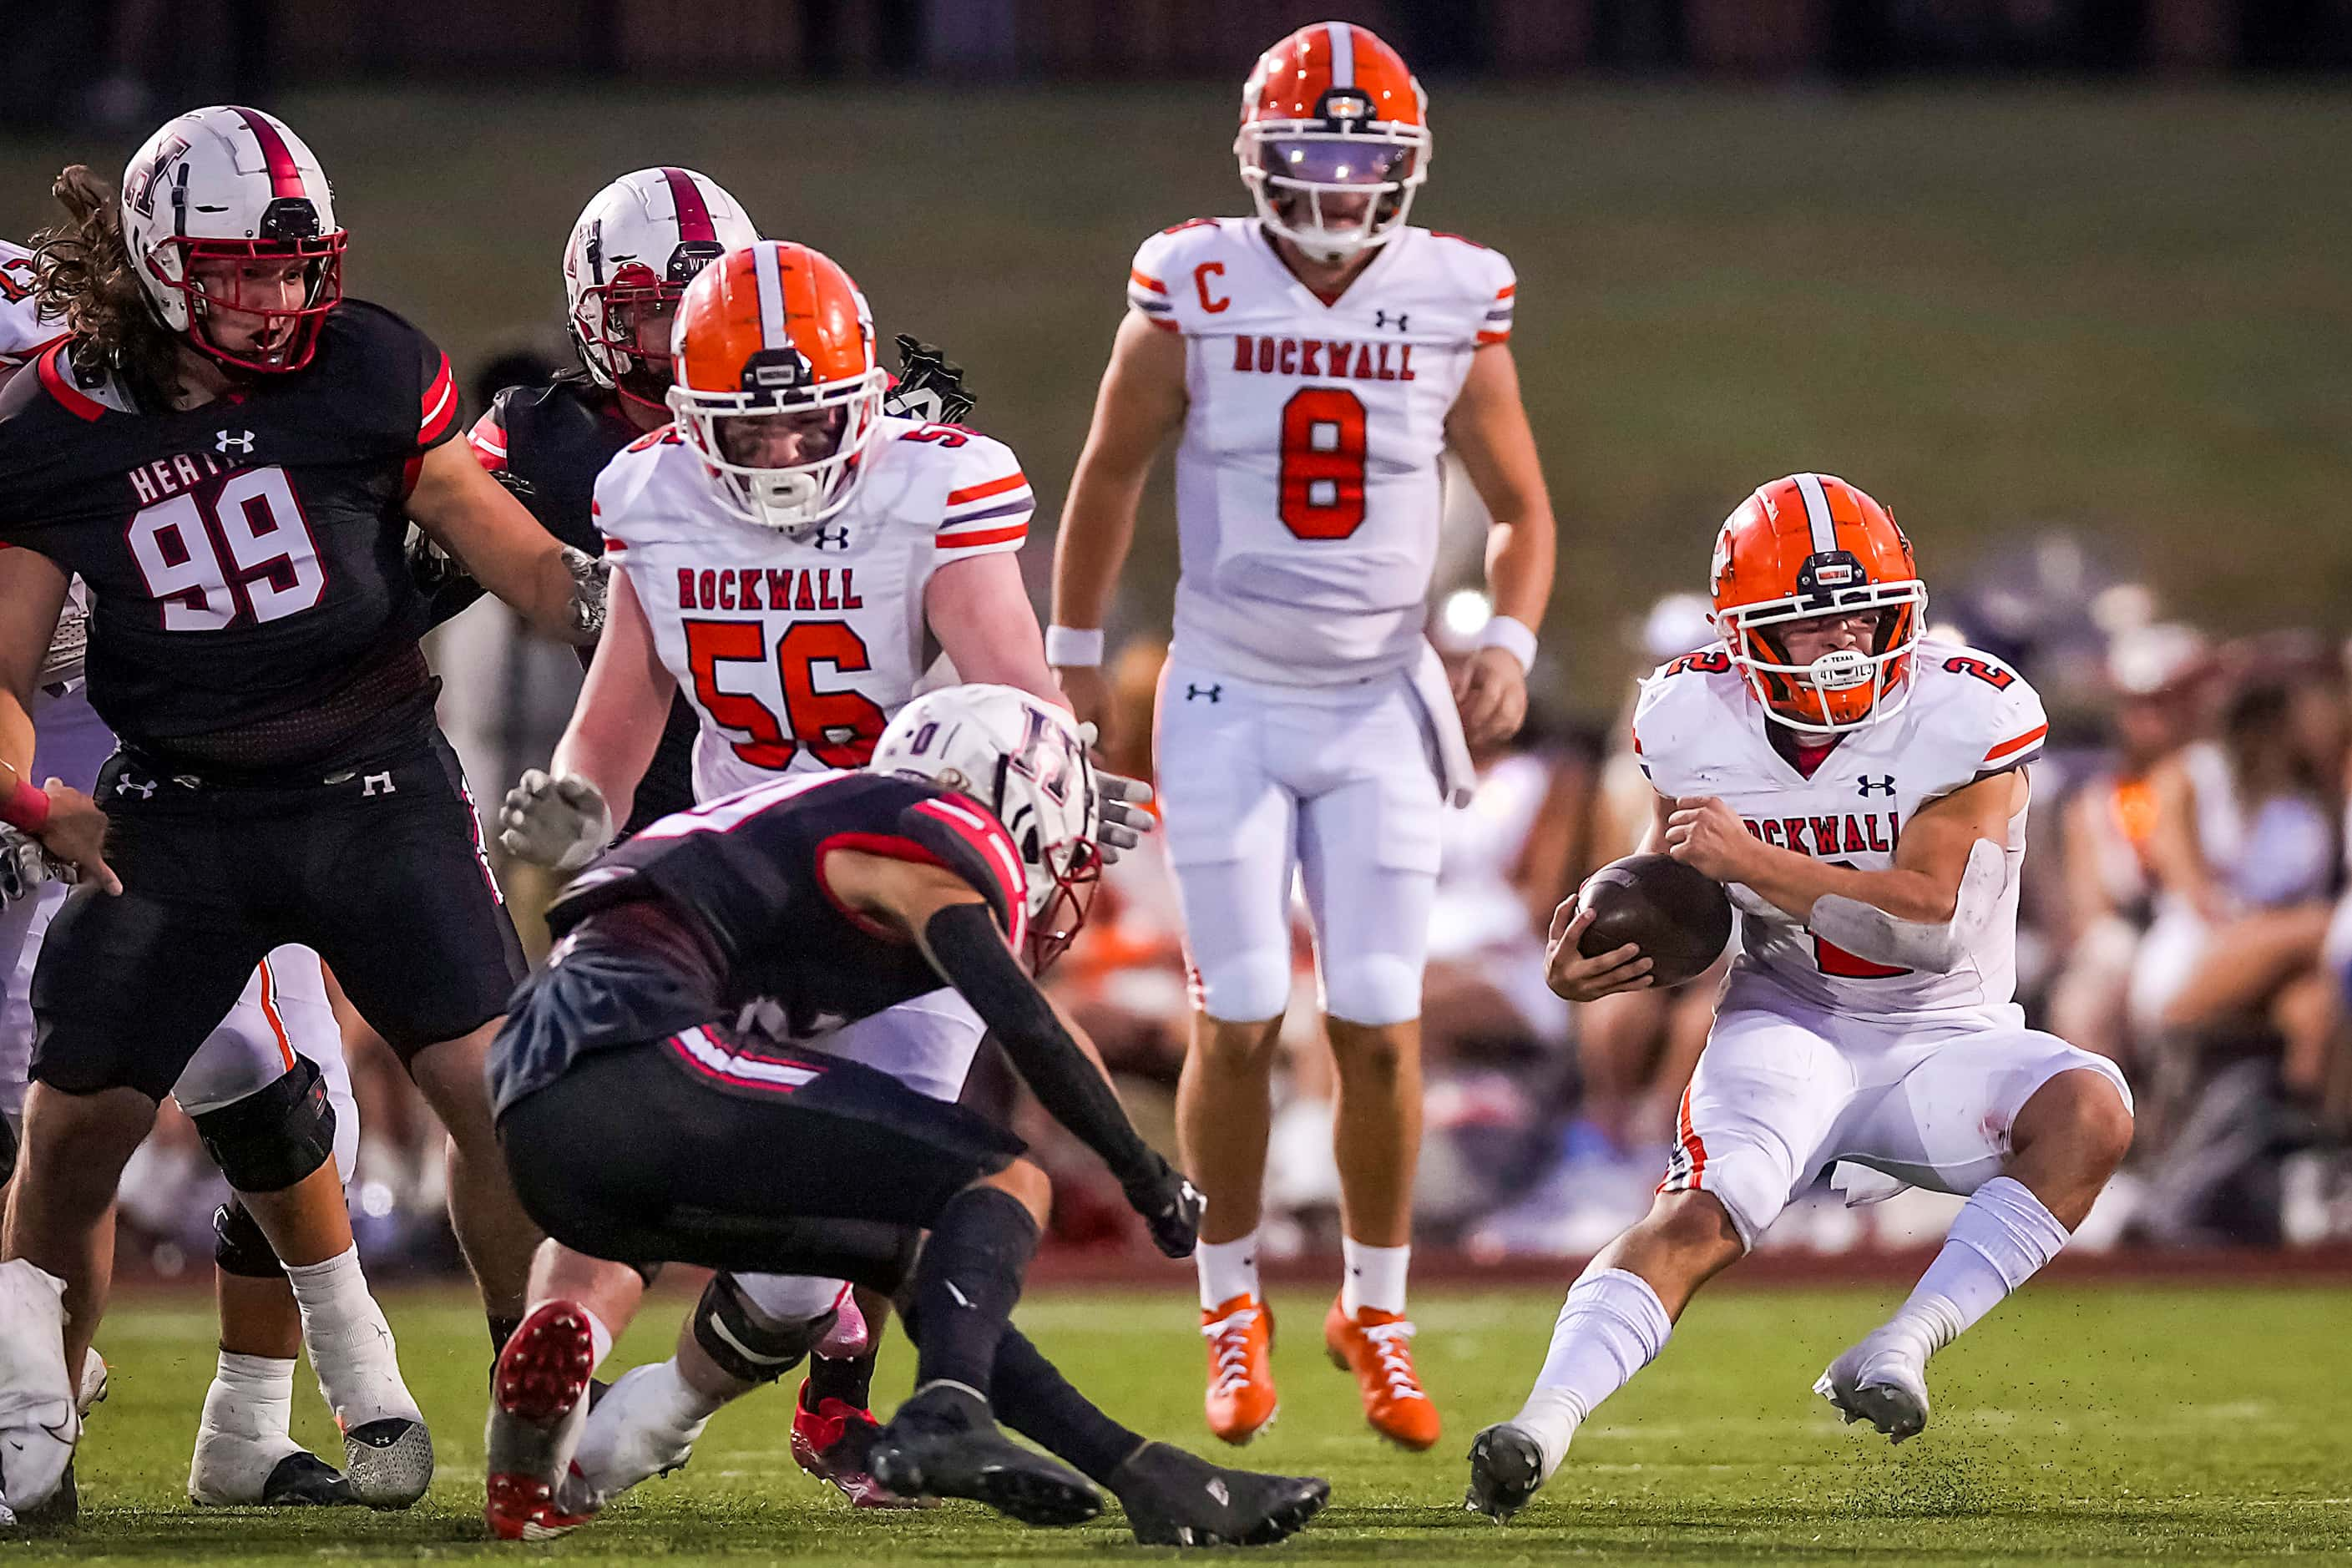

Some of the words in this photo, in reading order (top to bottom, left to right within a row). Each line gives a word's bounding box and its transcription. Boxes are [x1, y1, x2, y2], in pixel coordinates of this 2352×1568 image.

[1193, 261, 1231, 314] C
[1234, 334, 1416, 381] ROCKWALL
[1277, 385, 1367, 540] 8
[123, 463, 328, 632] 99
[677, 568, 863, 610] ROCKWALL
[681, 617, 890, 771] 56
[1942, 656, 2016, 693] 2
